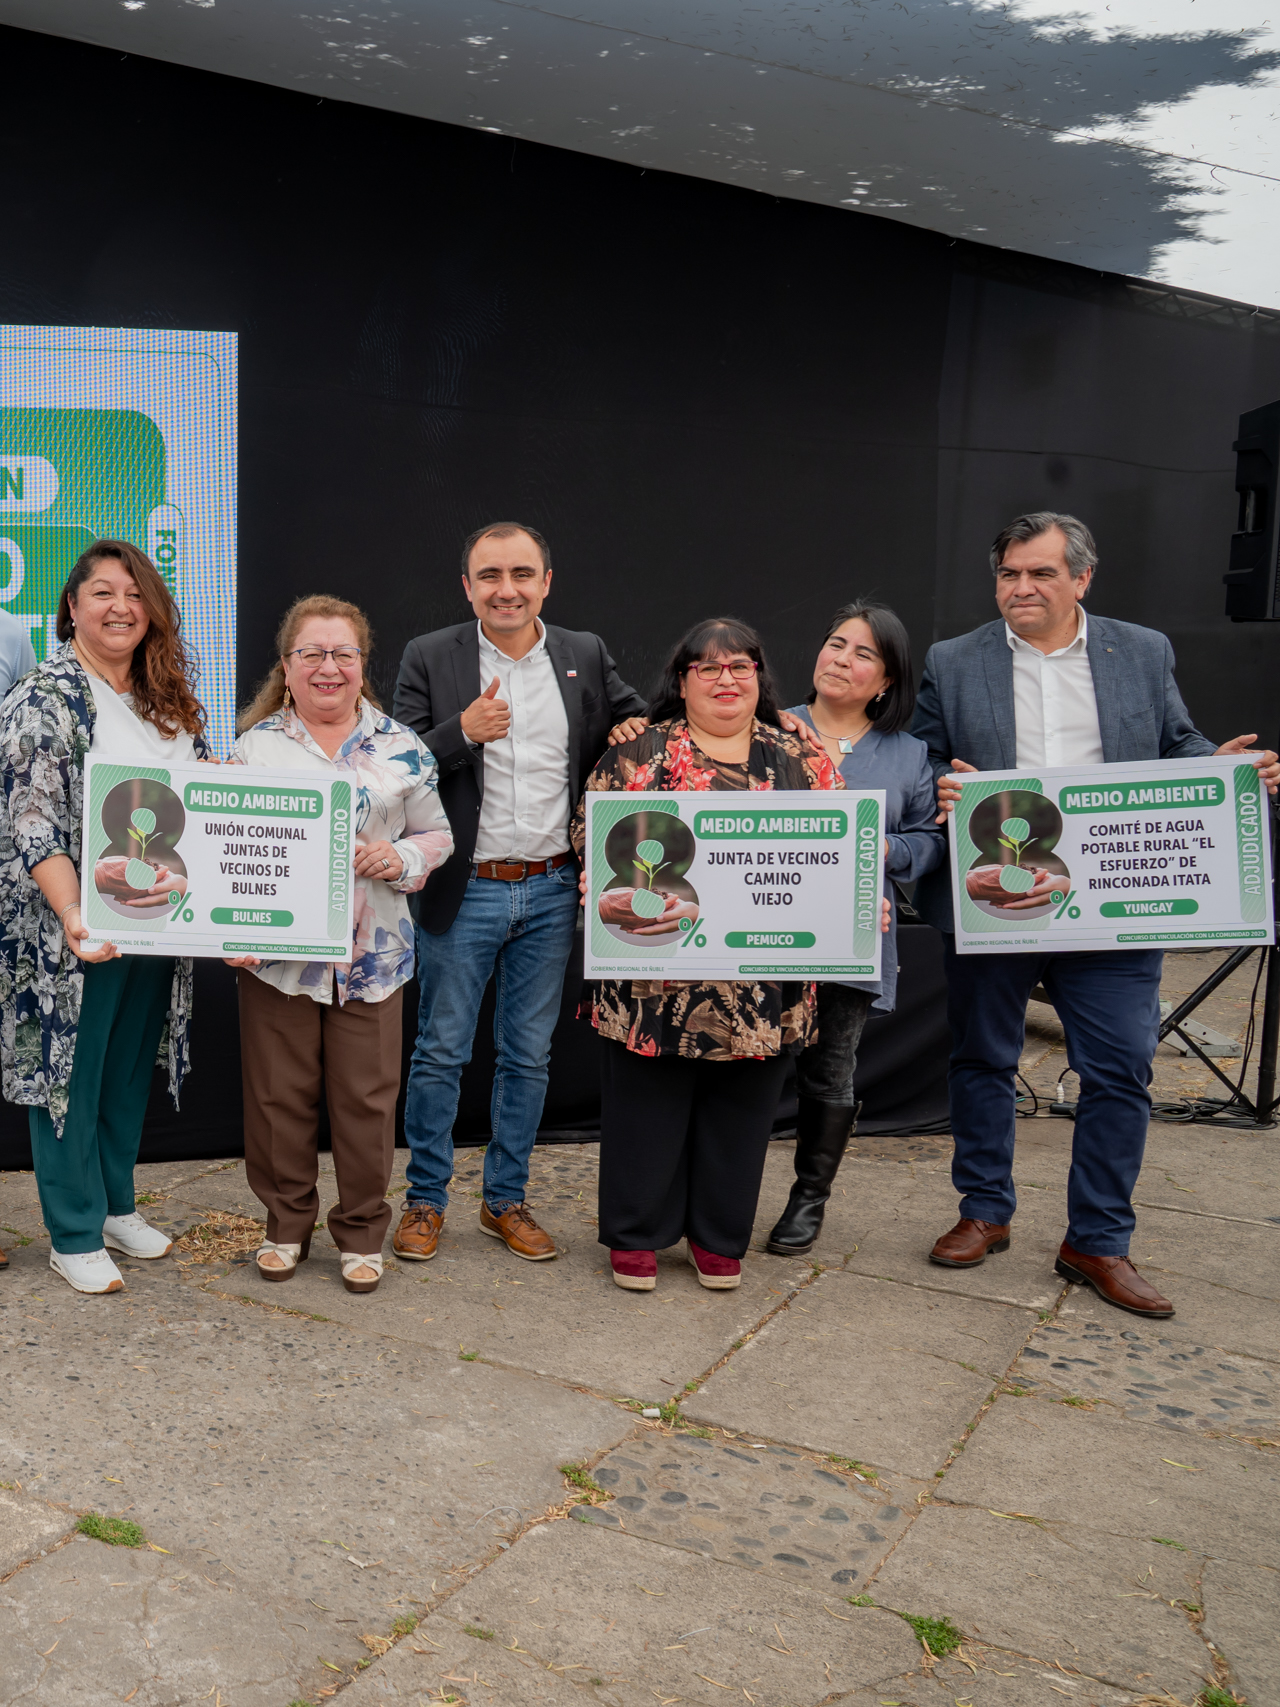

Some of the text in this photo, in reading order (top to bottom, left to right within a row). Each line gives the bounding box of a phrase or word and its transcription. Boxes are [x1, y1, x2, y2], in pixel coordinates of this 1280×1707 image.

[190, 790, 317, 813] MEDIO AMBIENTE
[1066, 784, 1218, 809] MEDIO AMBIENTE
[205, 821, 307, 841] UNIÓN COMUNAL
[700, 817, 841, 833] MEDIO AMBIENTE
[1089, 820, 1204, 837] COMITÉ DE AGUA
[223, 843, 287, 858] JUNTAS DE
[1081, 841, 1140, 855] POTABLE
[1144, 839, 1189, 852] RURAL
[1239, 792, 1261, 896] ADJUDICADO
[331, 808, 348, 913] ADJUDICADO
[708, 852, 839, 865] JUNTA DE VECINOS
[1179, 856, 1197, 868] DE
[220, 862, 290, 877] VECINOS DE
[744, 872, 801, 885] CAMINO
[857, 827, 876, 931] ADJUDICADO
[1089, 873, 1211, 890] RINCONADA ITATA
[232, 882, 277, 896] BULNES
[752, 893, 793, 905] VIEJO
[1123, 902, 1174, 915] YUNGAY
[232, 911, 272, 923] BULNES
[746, 935, 794, 946] PEMUCO
